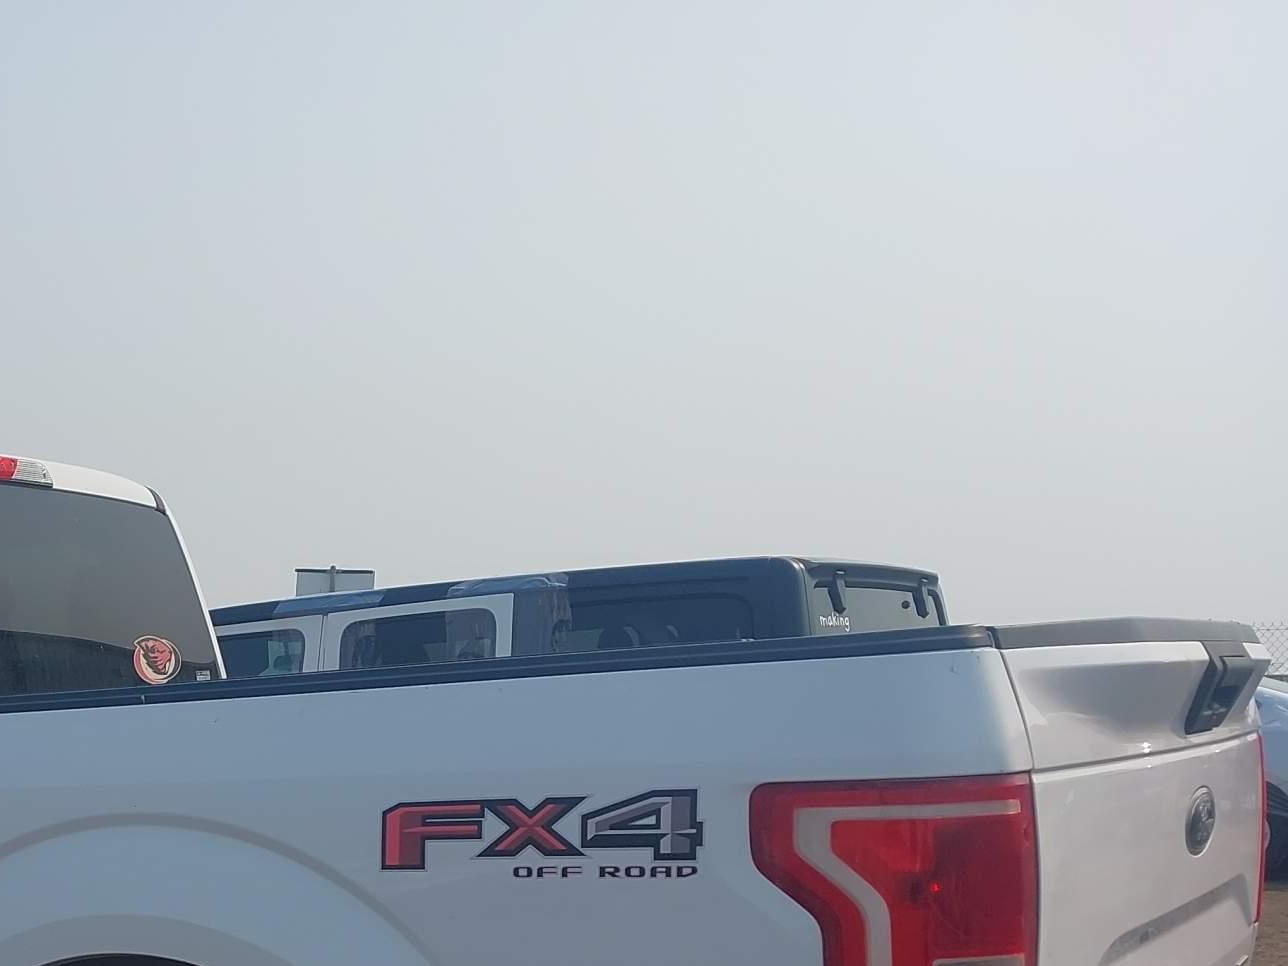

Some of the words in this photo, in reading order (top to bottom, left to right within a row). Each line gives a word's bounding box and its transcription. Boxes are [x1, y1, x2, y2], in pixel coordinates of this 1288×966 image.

[819, 611, 851, 633] making
[381, 788, 704, 871] FX4
[512, 865, 583, 879] OFF
[598, 865, 699, 879] ROAD
